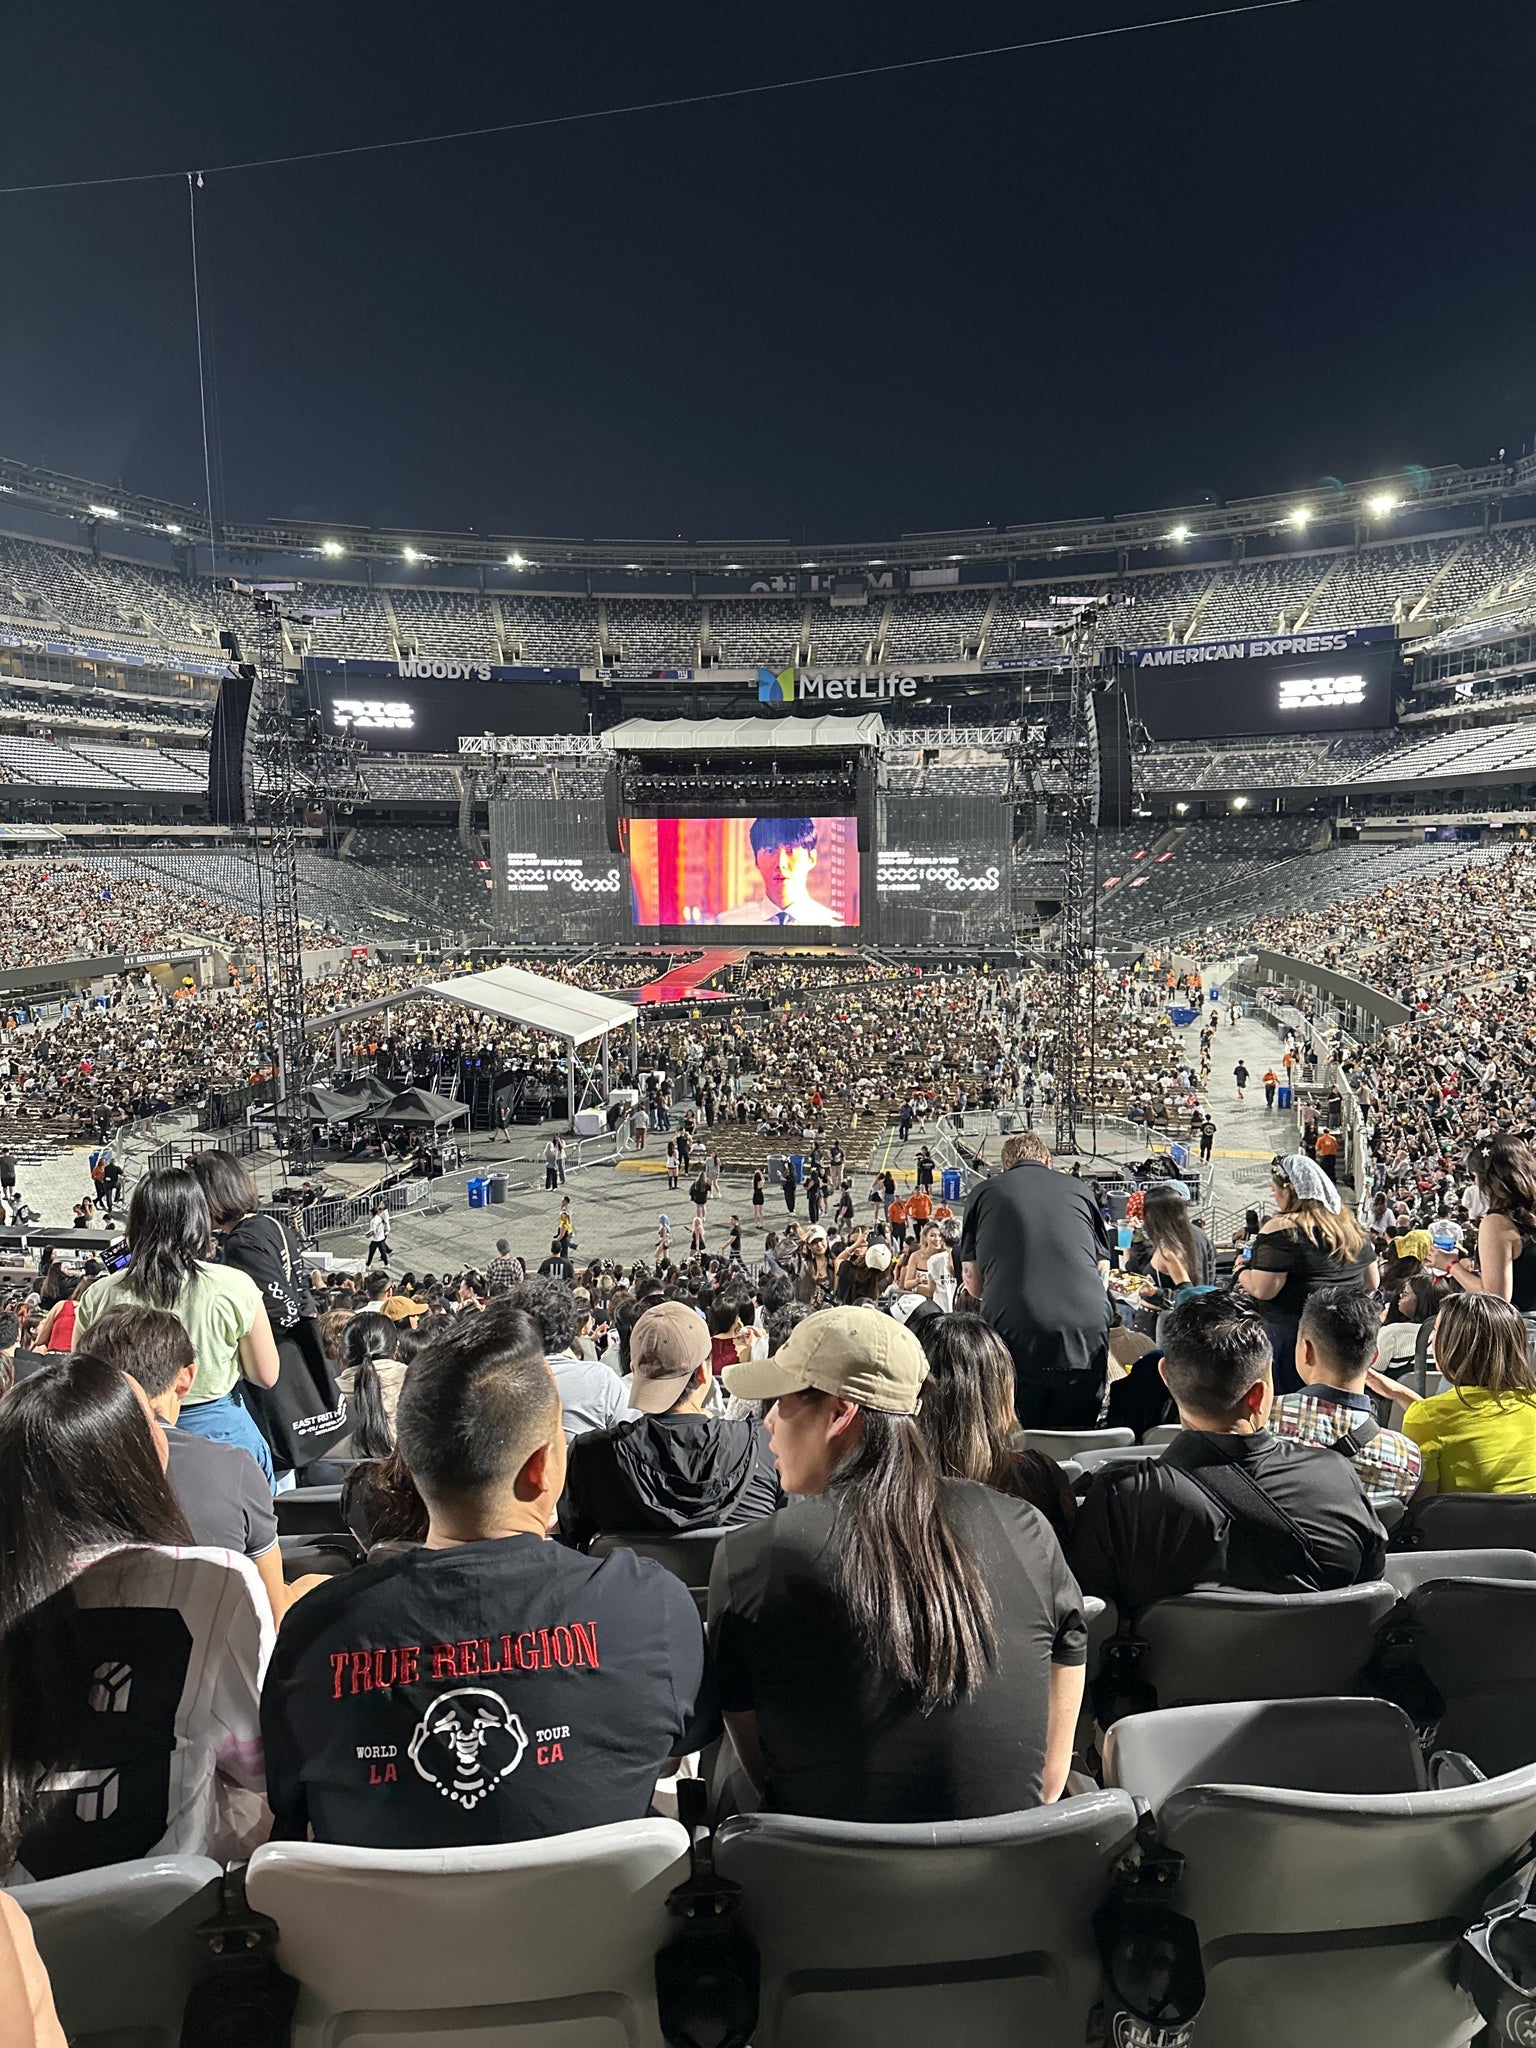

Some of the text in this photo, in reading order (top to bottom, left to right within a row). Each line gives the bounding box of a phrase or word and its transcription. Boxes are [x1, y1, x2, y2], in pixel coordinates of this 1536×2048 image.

[1139, 634, 1348, 667] AMERICAN EXPRESS
[398, 661, 492, 681] MOODY'S
[799, 671, 917, 699] MetLife
[1279, 676, 1367, 697] BIG
[136, 953, 166, 963] RESTROOMS
[171, 948, 203, 959] CONCESSIONS
[292, 1416, 317, 1430] EAST
[329, 1621, 600, 1699] TRUE RELIGION
[536, 1725, 571, 1742] TOUR
[356, 1745, 398, 1759] WORLD
[536, 1743, 565, 1766] CA
[369, 1762, 398, 1785] LA
